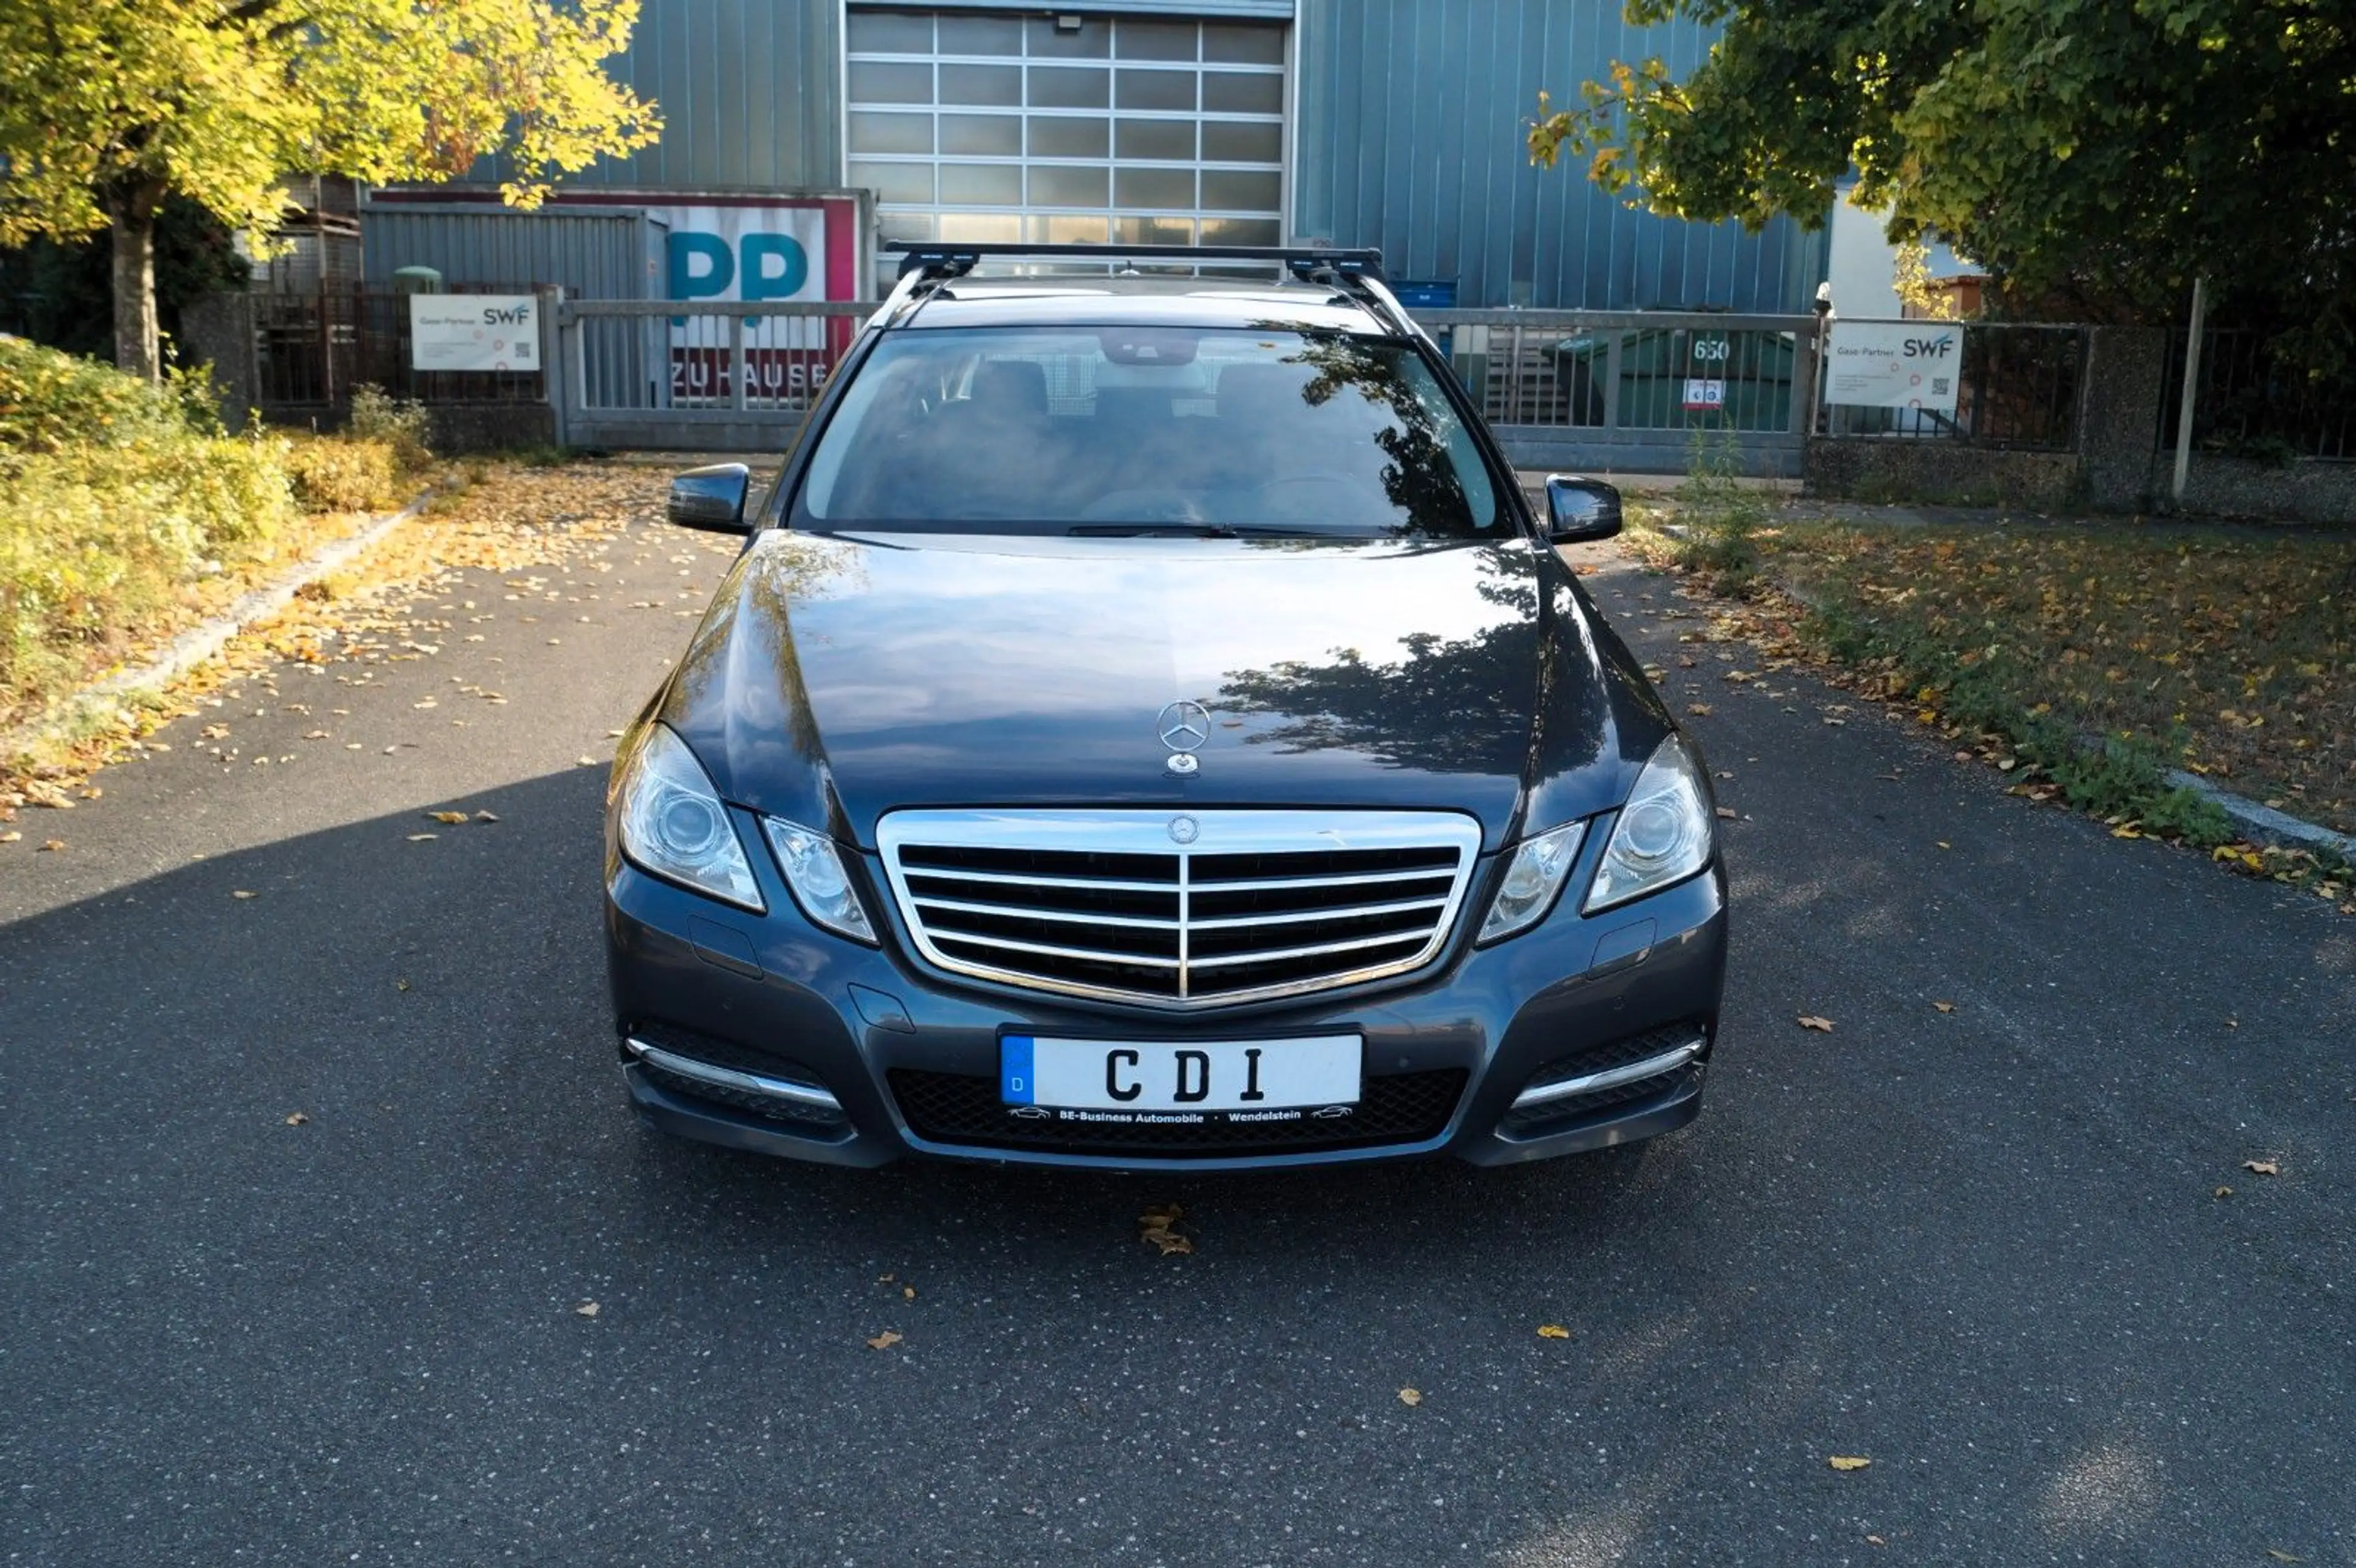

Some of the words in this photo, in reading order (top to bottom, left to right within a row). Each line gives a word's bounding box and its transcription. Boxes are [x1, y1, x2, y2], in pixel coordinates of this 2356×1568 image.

[483, 309, 529, 325] SWF
[1694, 340, 1730, 360] 650
[1903, 339, 1954, 358] SWF
[1012, 1077, 1023, 1092] D
[1060, 1110, 1132, 1123] BE-Business
[1135, 1113, 1204, 1123] Automobile
[1229, 1110, 1301, 1122] Wendelstein
